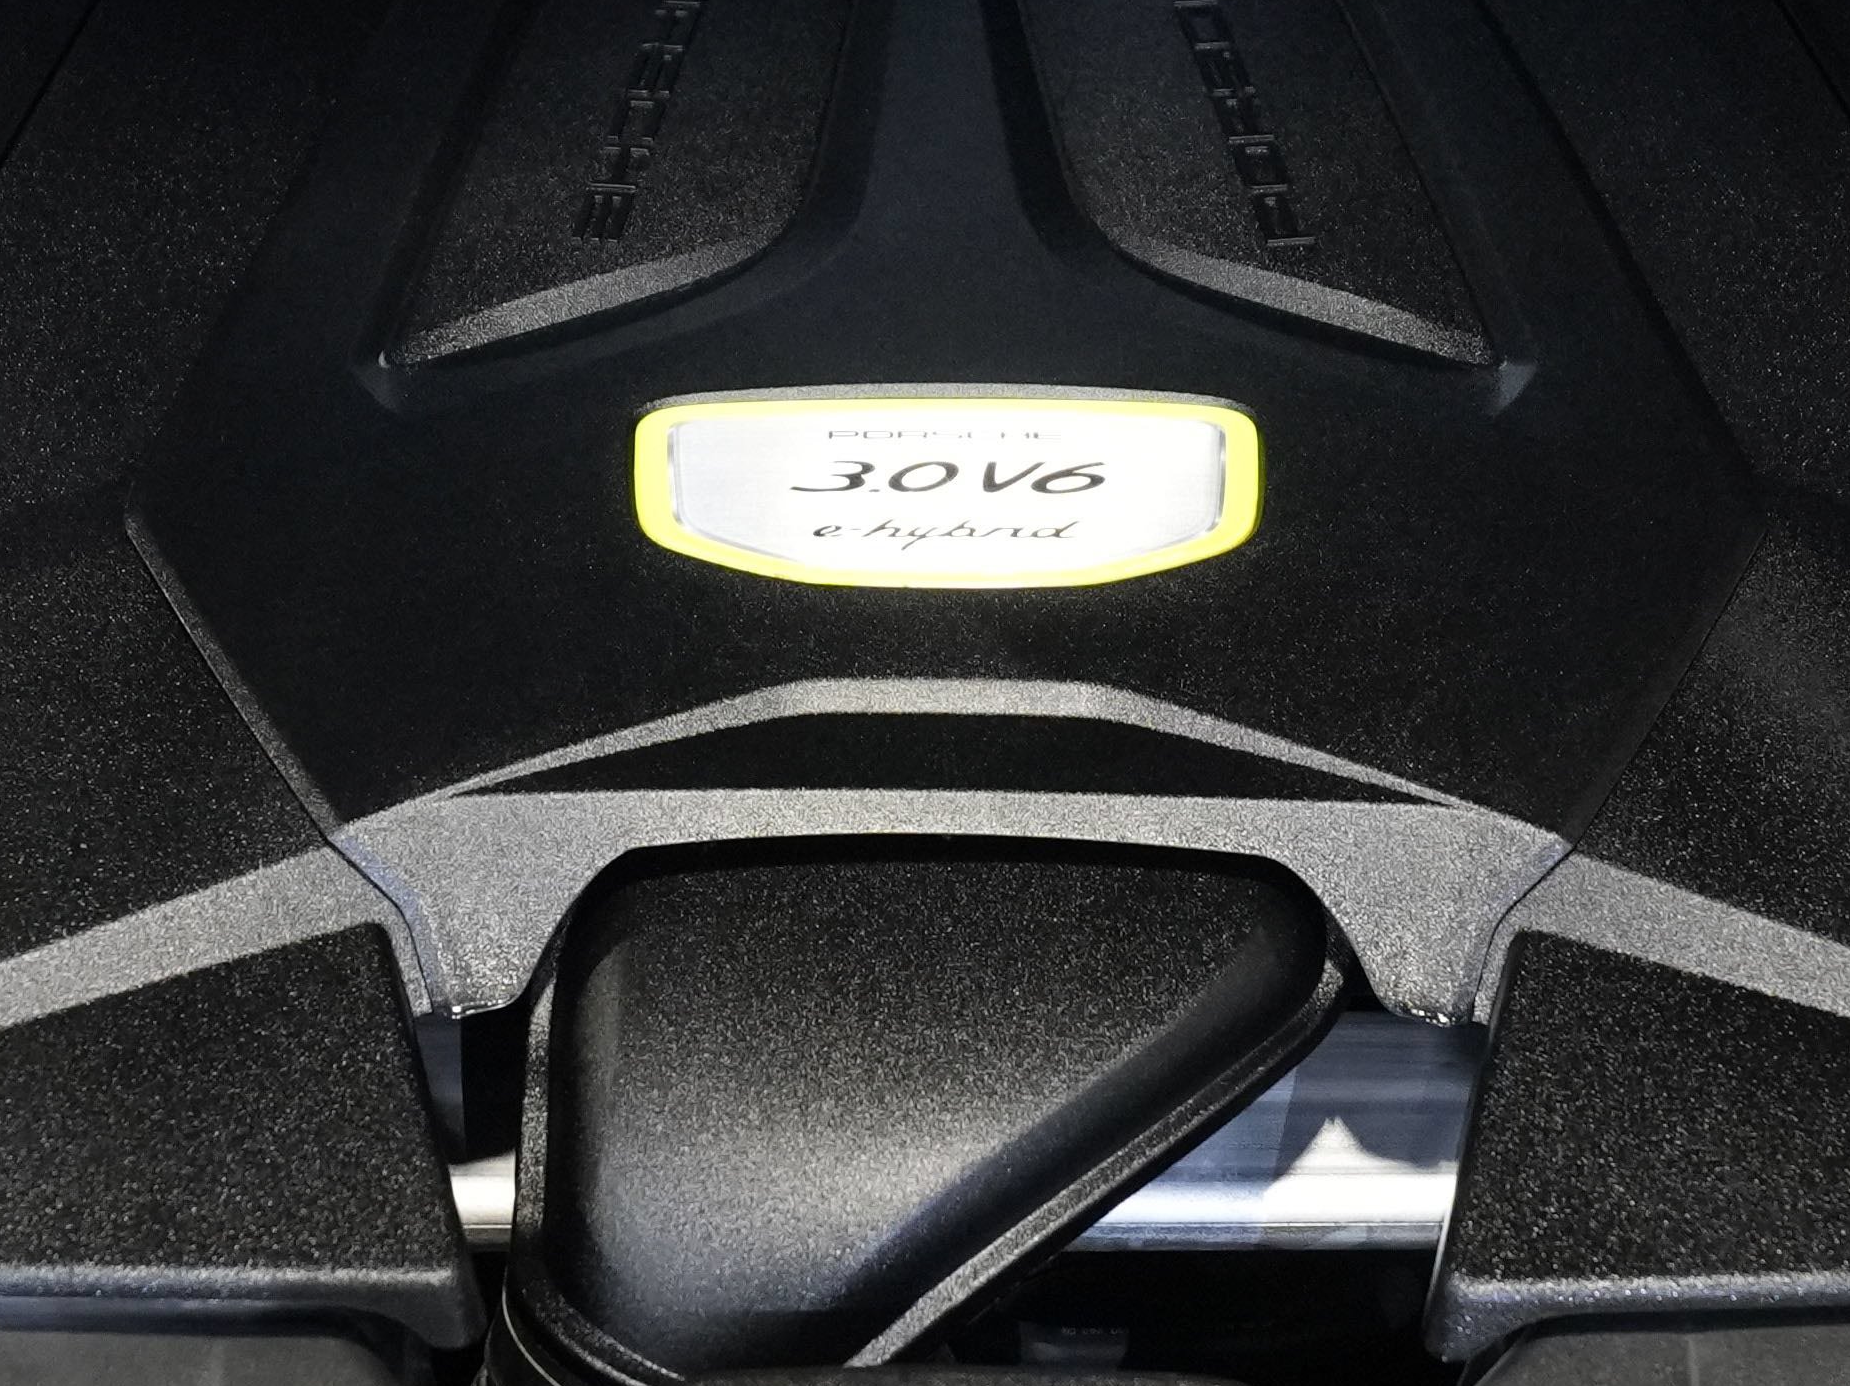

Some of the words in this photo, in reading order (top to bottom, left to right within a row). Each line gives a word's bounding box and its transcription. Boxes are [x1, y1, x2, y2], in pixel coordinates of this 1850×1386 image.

[789, 460, 959, 493] 3.0
[982, 460, 1106, 494] V6
[812, 519, 1080, 551] e-hybrid
